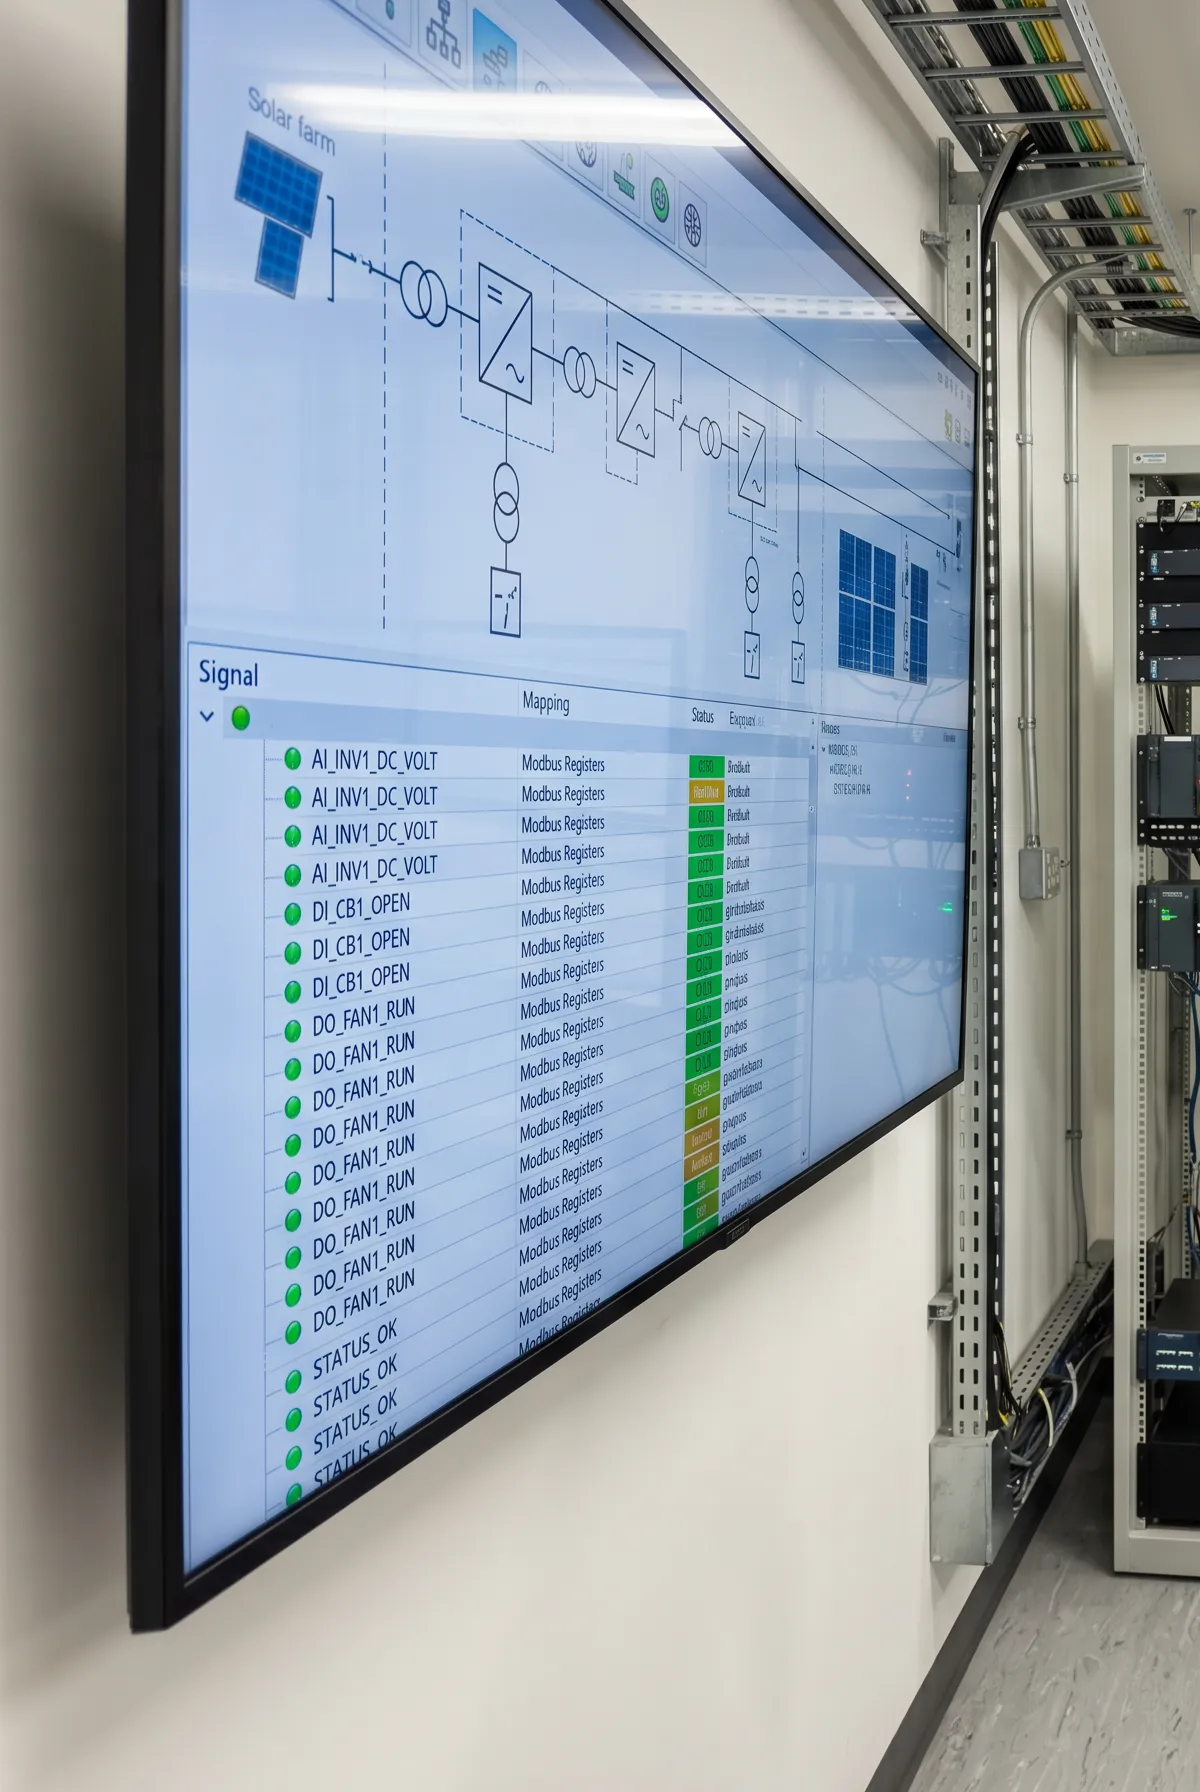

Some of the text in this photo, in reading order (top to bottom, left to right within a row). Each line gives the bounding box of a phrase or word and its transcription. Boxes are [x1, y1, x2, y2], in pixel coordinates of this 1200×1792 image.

[248, 86, 336, 156] Solar farm
[199, 659, 258, 690] Signal
[523, 691, 570, 716] Mapping
[692, 707, 715, 724] Status
[311, 748, 439, 775] AI_INV1_DC_VOLT
[522, 754, 606, 777] Modbus Registers
[311, 786, 439, 813] AI_INV1_DC_VOLT
[522, 785, 606, 807] Modbus Registers
[311, 820, 438, 850] AI_INV1_DC_VOLT
[521, 815, 605, 836] Modbus Registers
[311, 854, 439, 888] AI_INV1_DC_VOLT
[521, 844, 605, 866] Modbus Registers
[521, 872, 605, 896] Modbus Registers
[312, 891, 410, 926] DI_CB1_OPEN
[521, 901, 605, 928] Modbus Registers
[313, 926, 410, 963] DI_CB1_OPEN
[521, 930, 605, 959] Modbus Registers
[313, 961, 410, 1001] DI_CB1_OPEN
[520, 958, 605, 990] Modbus Registers
[313, 995, 415, 1037] DO_FAN1_RUN
[520, 987, 605, 1021] Modbus Registers
[313, 1030, 415, 1075] DO_FAN1_RUN
[520, 1016, 604, 1052] Modbus Registers
[520, 1044, 604, 1083] Modbus Registers
[313, 1064, 415, 1113] DO_FAN1_RUN
[520, 1072, 604, 1113] Modbus Registers
[313, 1098, 415, 1149] DO_FAN1_RUN
[520, 1100, 604, 1144] Modbus Registers
[313, 1132, 415, 1187] DO_FAN1_RUN
[519, 1128, 604, 1174] Modbus Registers
[313, 1166, 415, 1223] DO_FAN1_RUN
[519, 1156, 603, 1205] Modbus Registers
[519, 1184, 603, 1236] Modbus Registers
[313, 1200, 415, 1261] DO_FAN1_RUN
[519, 1212, 603, 1267] Modbus Registers
[313, 1233, 415, 1297] DO_FAN1_RUN
[519, 1240, 602, 1298] Modbus Registers
[313, 1267, 415, 1333] DO_FAN1_RUN
[519, 1268, 602, 1329] Modbus Registers
[313, 1317, 398, 1381] STATUS_OK
[313, 1352, 398, 1418] STATUS_OK
[313, 1387, 398, 1456] STATUS_OK
